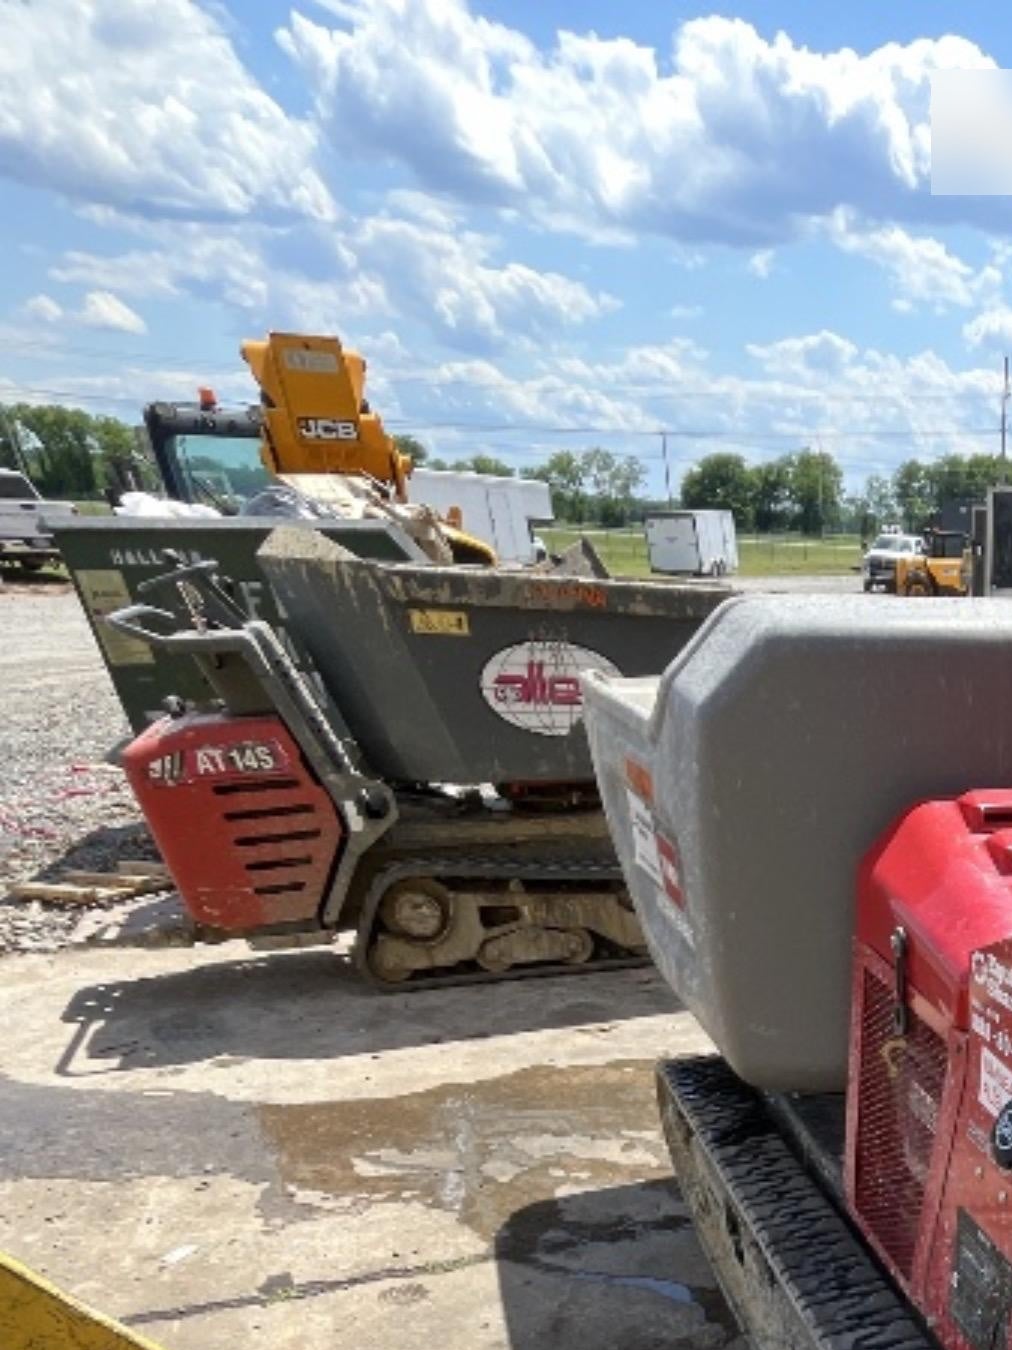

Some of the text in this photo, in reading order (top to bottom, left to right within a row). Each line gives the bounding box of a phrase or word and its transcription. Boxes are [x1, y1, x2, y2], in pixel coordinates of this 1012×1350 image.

[301, 419, 358, 440] JCB
[493, 660, 584, 706] alle
[196, 748, 226, 775] AT
